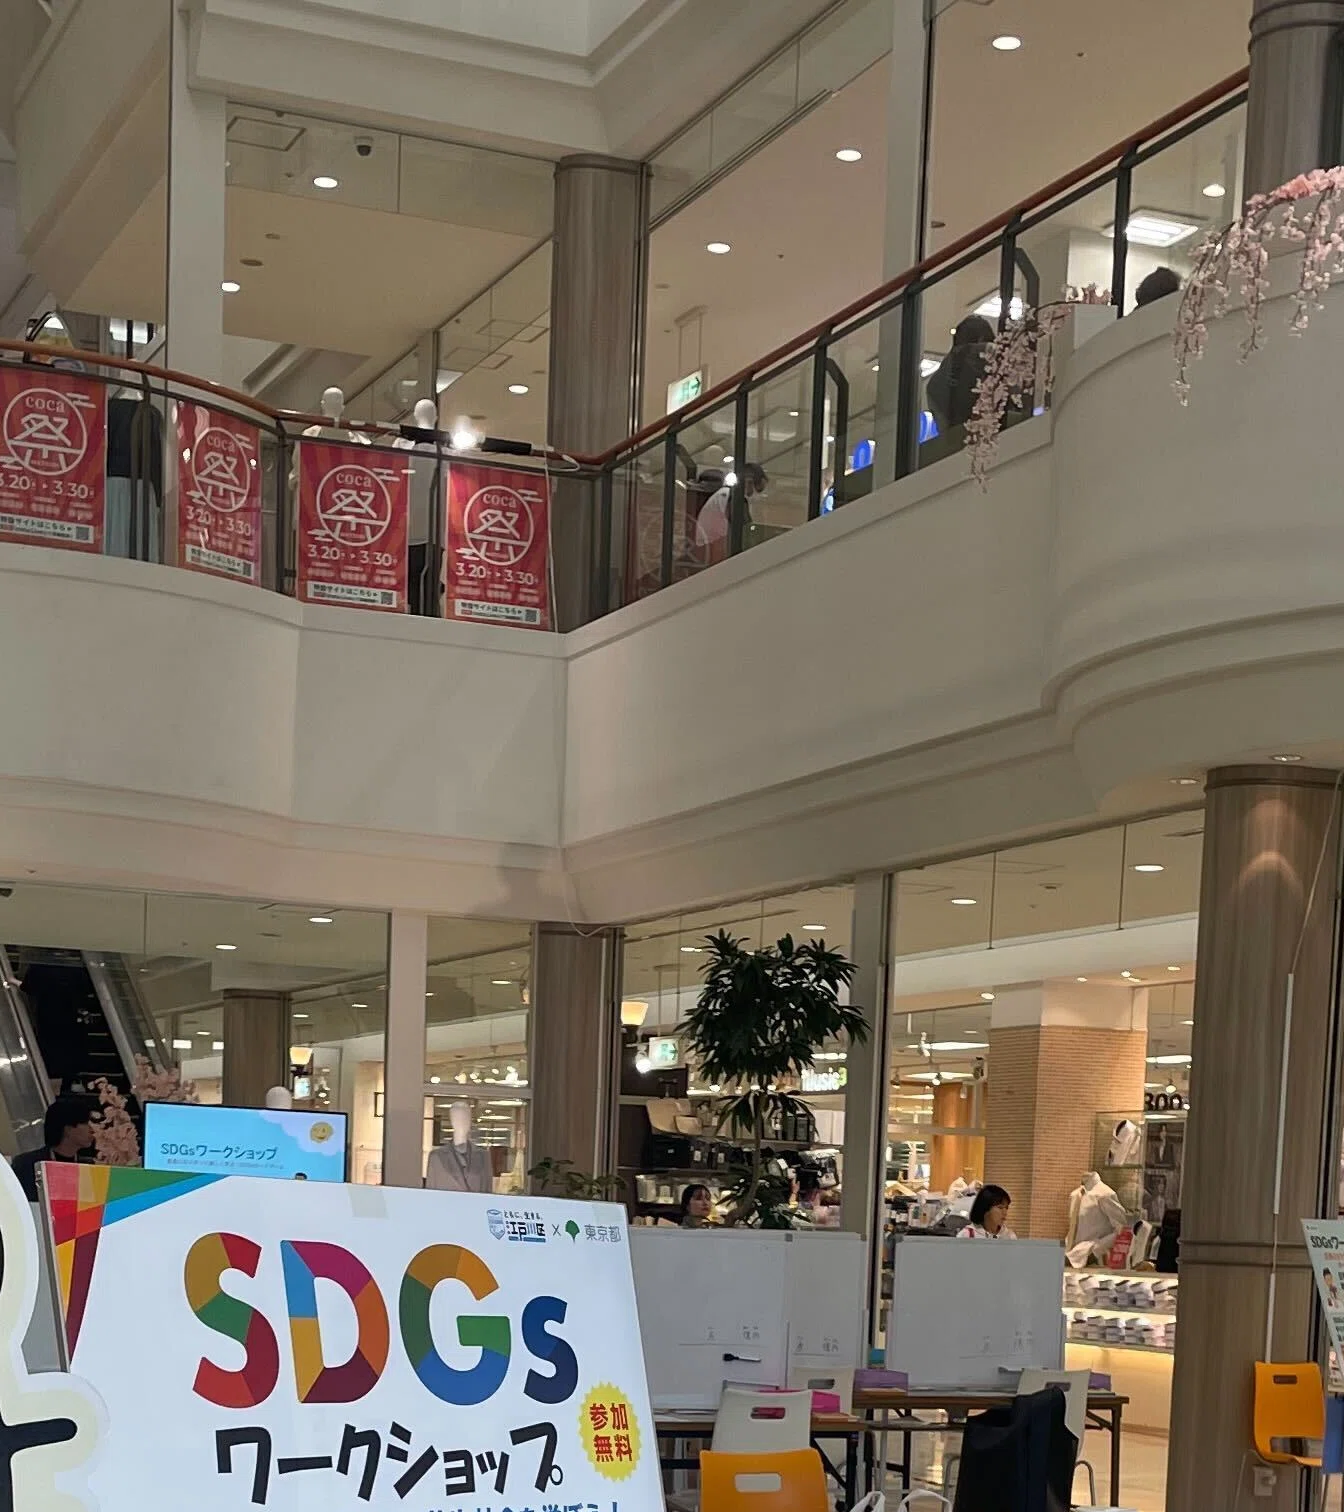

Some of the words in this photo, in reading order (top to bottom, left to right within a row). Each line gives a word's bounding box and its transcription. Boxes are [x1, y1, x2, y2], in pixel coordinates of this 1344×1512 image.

[25, 397, 65, 413] coca
[206, 435, 235, 452] coca
[336, 473, 372, 487] coca
[482, 493, 517, 508] coca
[160, 1143, 279, 1161] SDGsワークショップ
[584, 1224, 622, 1243] 東京都
[183, 1230, 579, 1409] SDGs
[590, 1403, 629, 1430] 参加
[594, 1434, 632, 1462] 無料
[215, 1420, 564, 1504] ワークショップ
